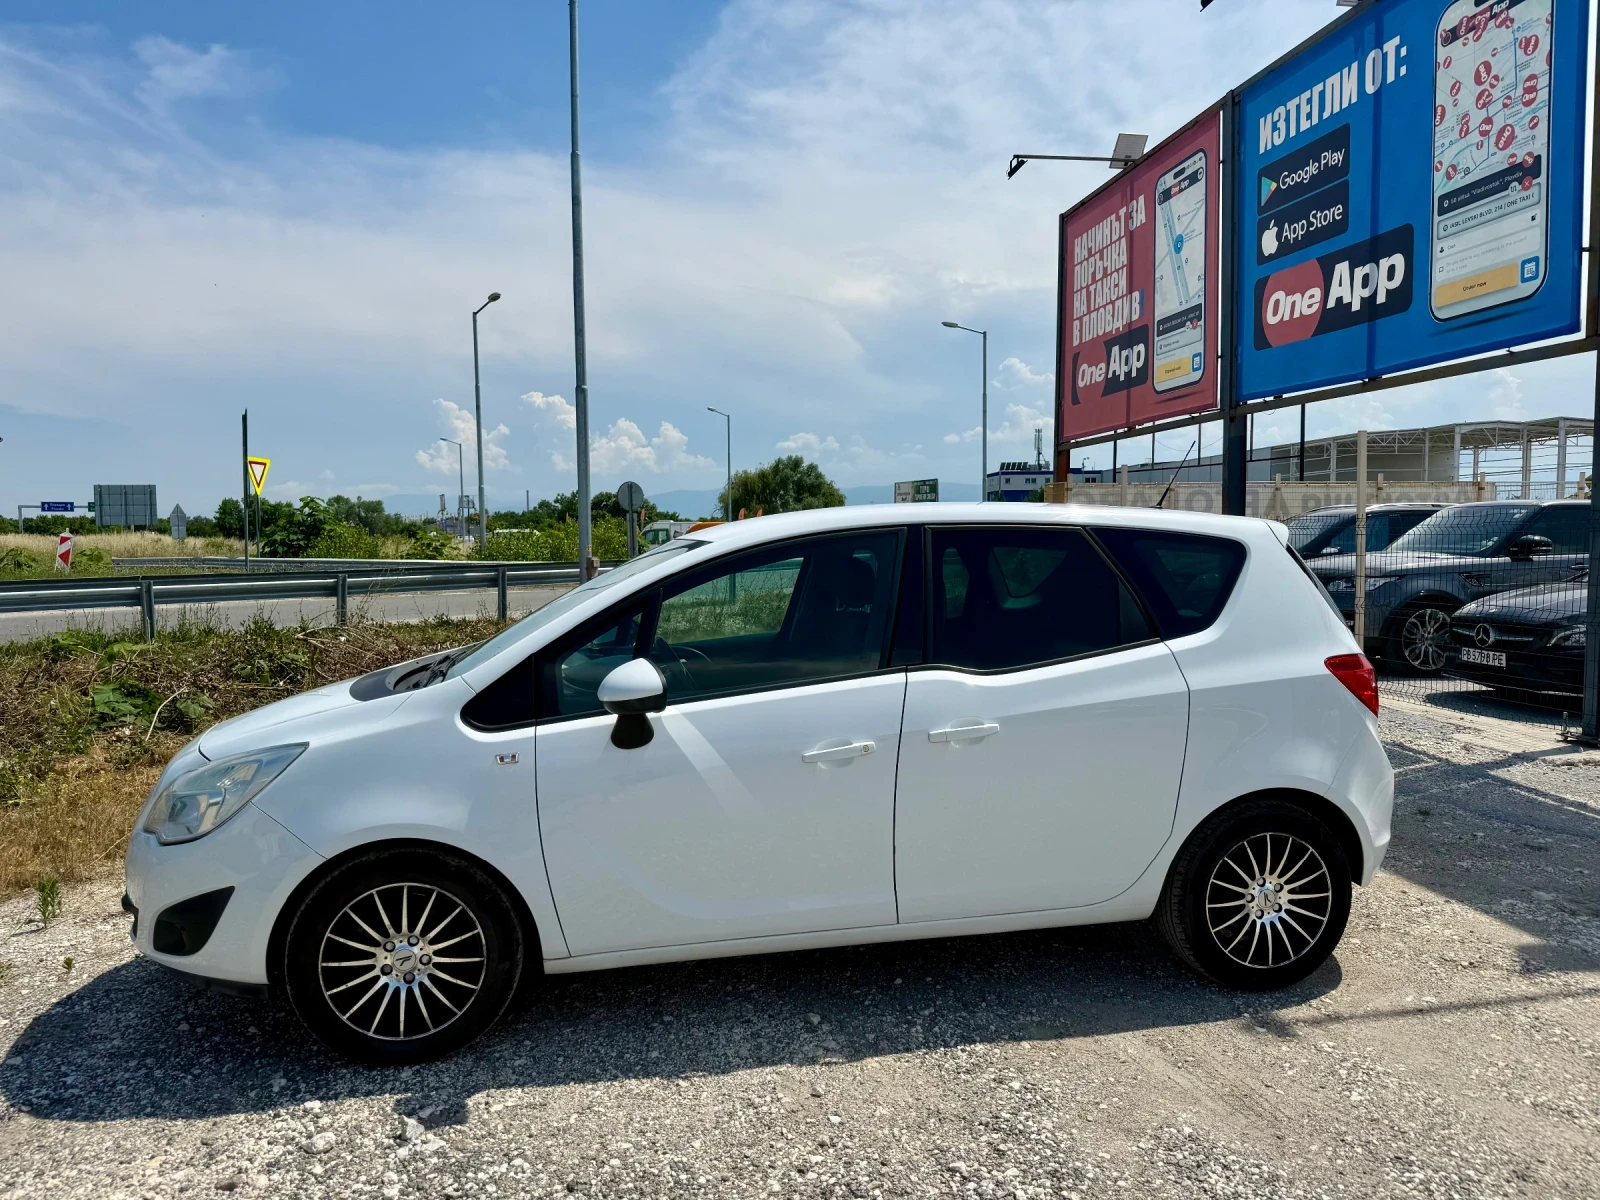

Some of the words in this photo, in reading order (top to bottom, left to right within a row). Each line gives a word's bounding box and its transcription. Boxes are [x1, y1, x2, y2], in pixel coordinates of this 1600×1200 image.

[1527, 36, 1536, 54] One
[1479, 64, 1488, 82] One
[1259, 61, 1357, 155] ИЗТЕГЛИ
[1365, 35, 1407, 95] ОТ:
[1479, 123, 1492, 131] One
[1498, 126, 1512, 148] One
[1279, 160, 1319, 189] Google
[1320, 148, 1345, 176] Play
[1504, 171, 1523, 183] Plovdiv
[1494, 204, 1503, 212] 214
[1506, 198, 1518, 208] ONE
[1519, 193, 1531, 203] TAXI
[1074, 206, 1127, 265] НАЧИНЪТ
[1128, 194, 1146, 231] ЗА
[1282, 218, 1306, 243] App
[1309, 203, 1343, 233] Store
[1074, 237, 1127, 292] ПОРЪЧКА
[1073, 288, 1087, 320] НА
[1089, 266, 1127, 312] ТАКСИ
[1266, 286, 1321, 325] One
[1326, 252, 1405, 312] App
[1073, 319, 1080, 347] В
[1077, 358, 1105, 388] One
[1107, 342, 1146, 379] App
